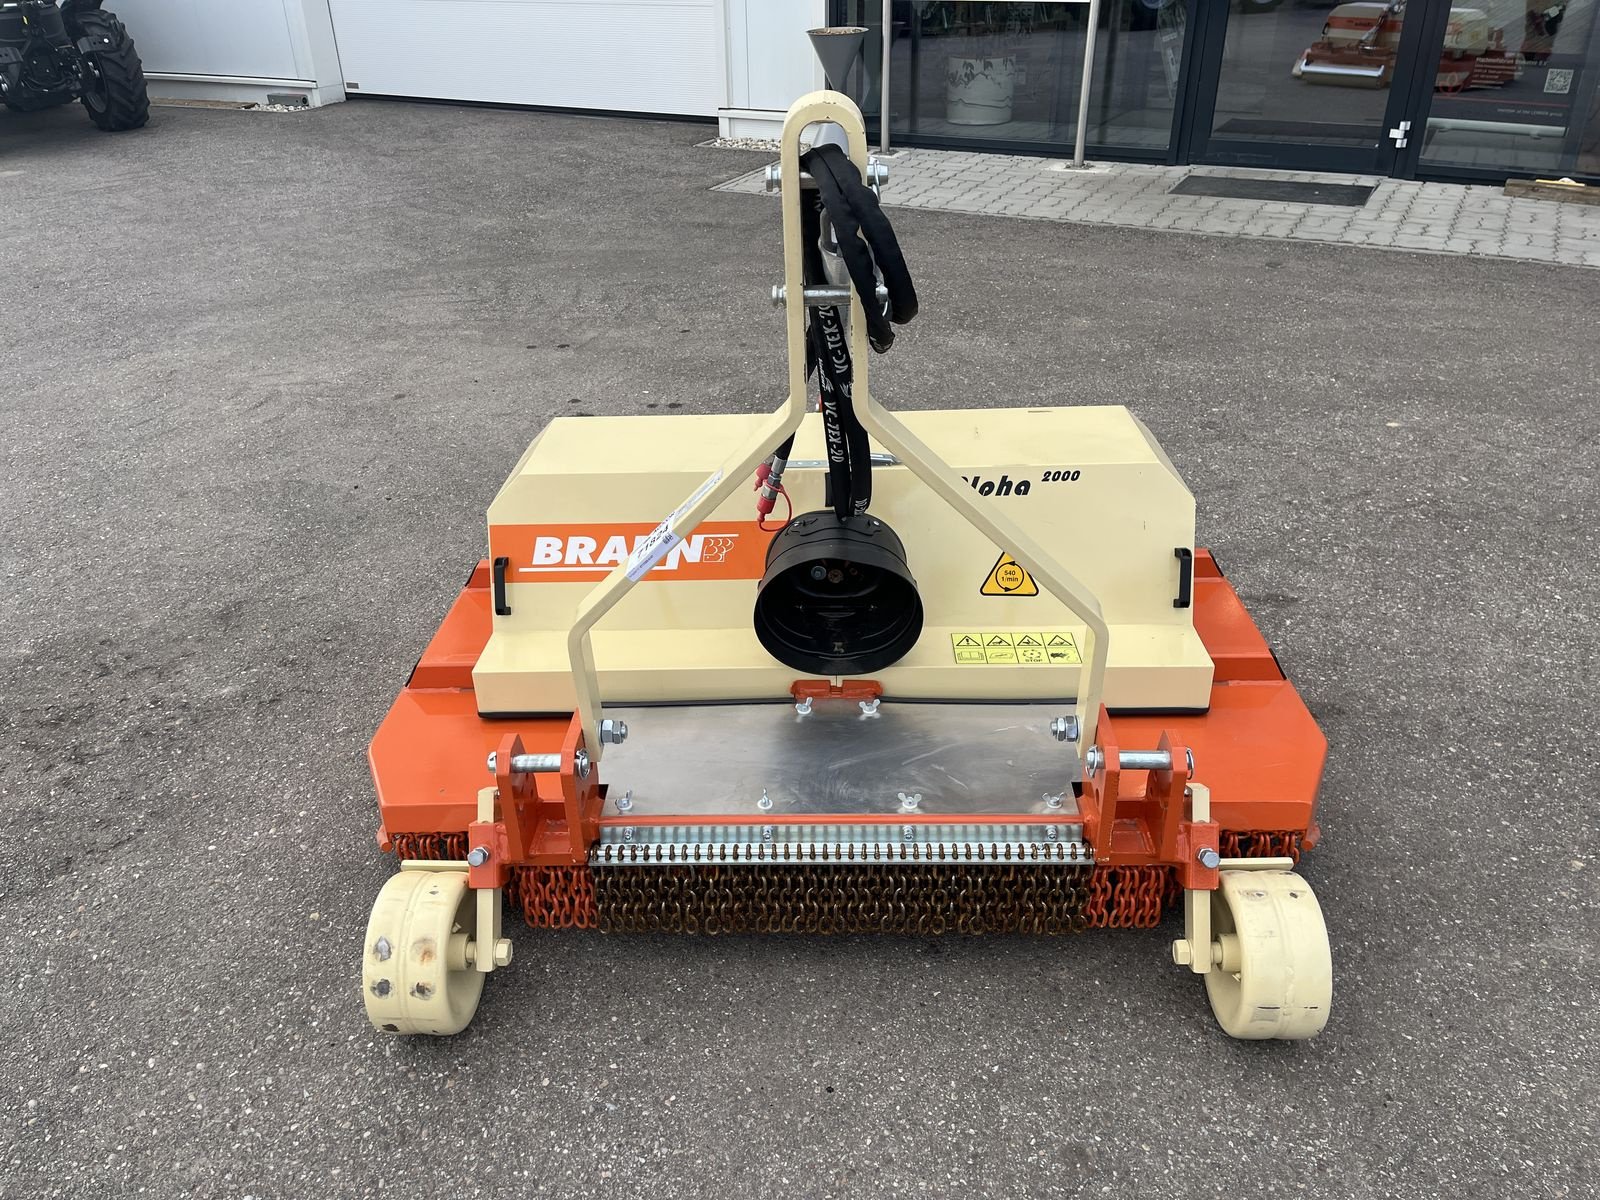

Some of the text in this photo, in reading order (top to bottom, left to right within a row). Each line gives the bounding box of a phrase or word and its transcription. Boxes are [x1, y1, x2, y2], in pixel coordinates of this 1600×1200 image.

[824, 401, 845, 463] VC-TEX-20
[961, 470, 1081, 497] lpha 2000
[532, 534, 704, 568] BRAN
